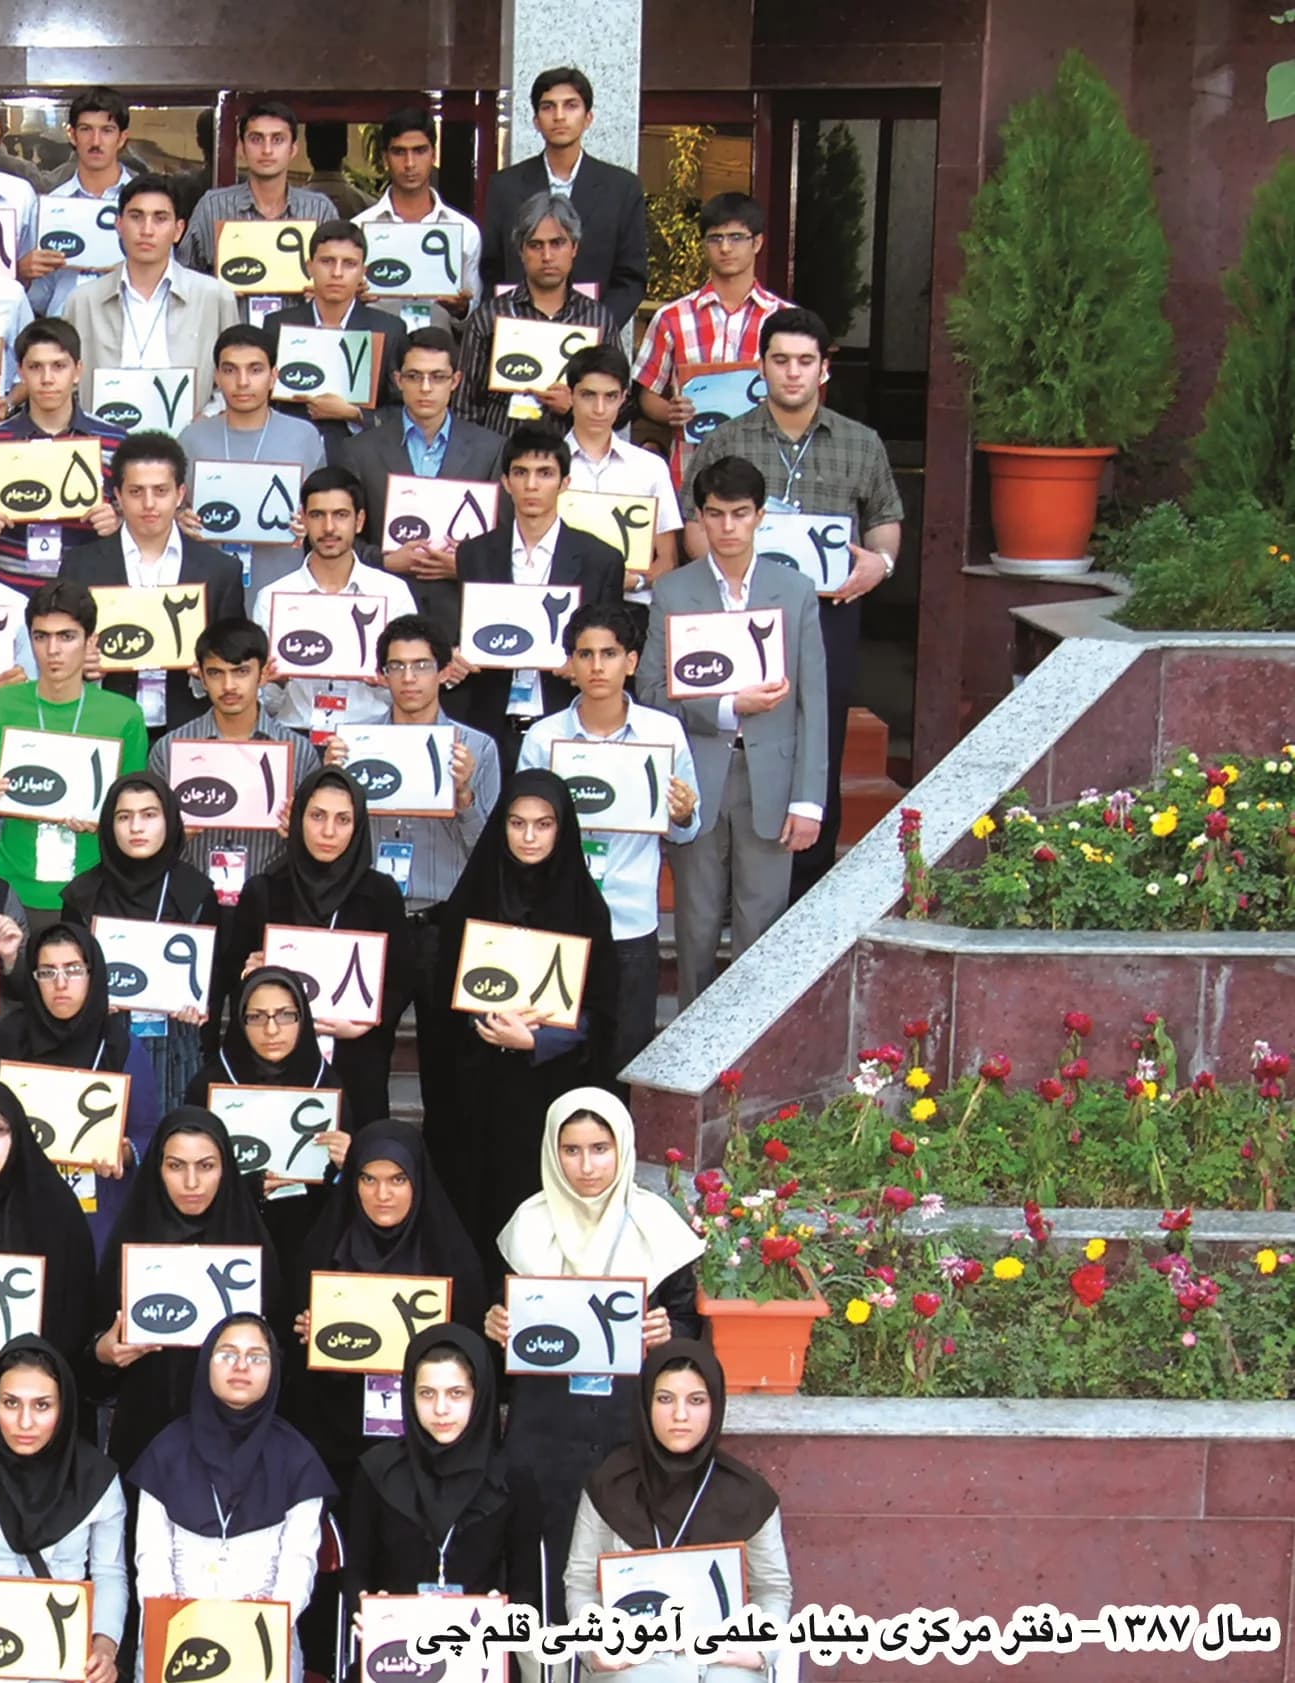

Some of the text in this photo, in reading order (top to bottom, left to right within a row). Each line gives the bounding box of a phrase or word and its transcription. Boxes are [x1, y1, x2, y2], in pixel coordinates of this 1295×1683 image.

[48, 239, 76, 250] اشنویه
[276, 227, 310, 280] ۹
[422, 230, 457, 284] ۹
[374, 266, 404, 279] جیرفت
[286, 371, 317, 385] جیرفت
[339, 337, 368, 392] ۷
[505, 363, 534, 375] جاجرم
[153, 375, 189, 428] ۷
[60, 451, 98, 508] ۵
[258, 475, 295, 531] ۵
[203, 509, 234, 524] کرمان
[396, 525, 421, 539] تبریز
[447, 490, 487, 541] ۵
[612, 505, 649, 561] ۴
[808, 524, 846, 584] ۴
[104, 632, 144, 653] تهران
[163, 594, 199, 658] ۳
[351, 604, 378, 667] ۲
[490, 634, 517, 649] تهران
[542, 592, 570, 644] ۲
[286, 639, 325, 657] شهرضا
[684, 659, 723, 678] یاسوج
[748, 618, 774, 681] ۲
[8, 776, 55, 792] کامیاران
[91, 749, 102, 810] ۱
[260, 752, 274, 814] ۱
[426, 734, 441, 796] ۱
[644, 755, 658, 818] ۱
[181, 788, 226, 804] برازجان
[108, 971, 136, 987] شیراز
[164, 934, 202, 1001] ۹
[331, 942, 373, 1008] ۸
[474, 979, 506, 996] تهران
[530, 944, 573, 1010] ۸
[71, 1082, 117, 1153] ۶
[286, 1098, 331, 1171] ۶
[234, 1144, 258, 1162] تهرا
[206, 1259, 256, 1314] ۴
[328, 1332, 371, 1348] سیرجان
[392, 1290, 442, 1340] ۴
[588, 1291, 638, 1365] ۴
[526, 1336, 564, 1352] بهبهان
[46, 1593, 79, 1668] ۲
[255, 1612, 272, 1680] ۱
[172, 1648, 218, 1675] کرمان
